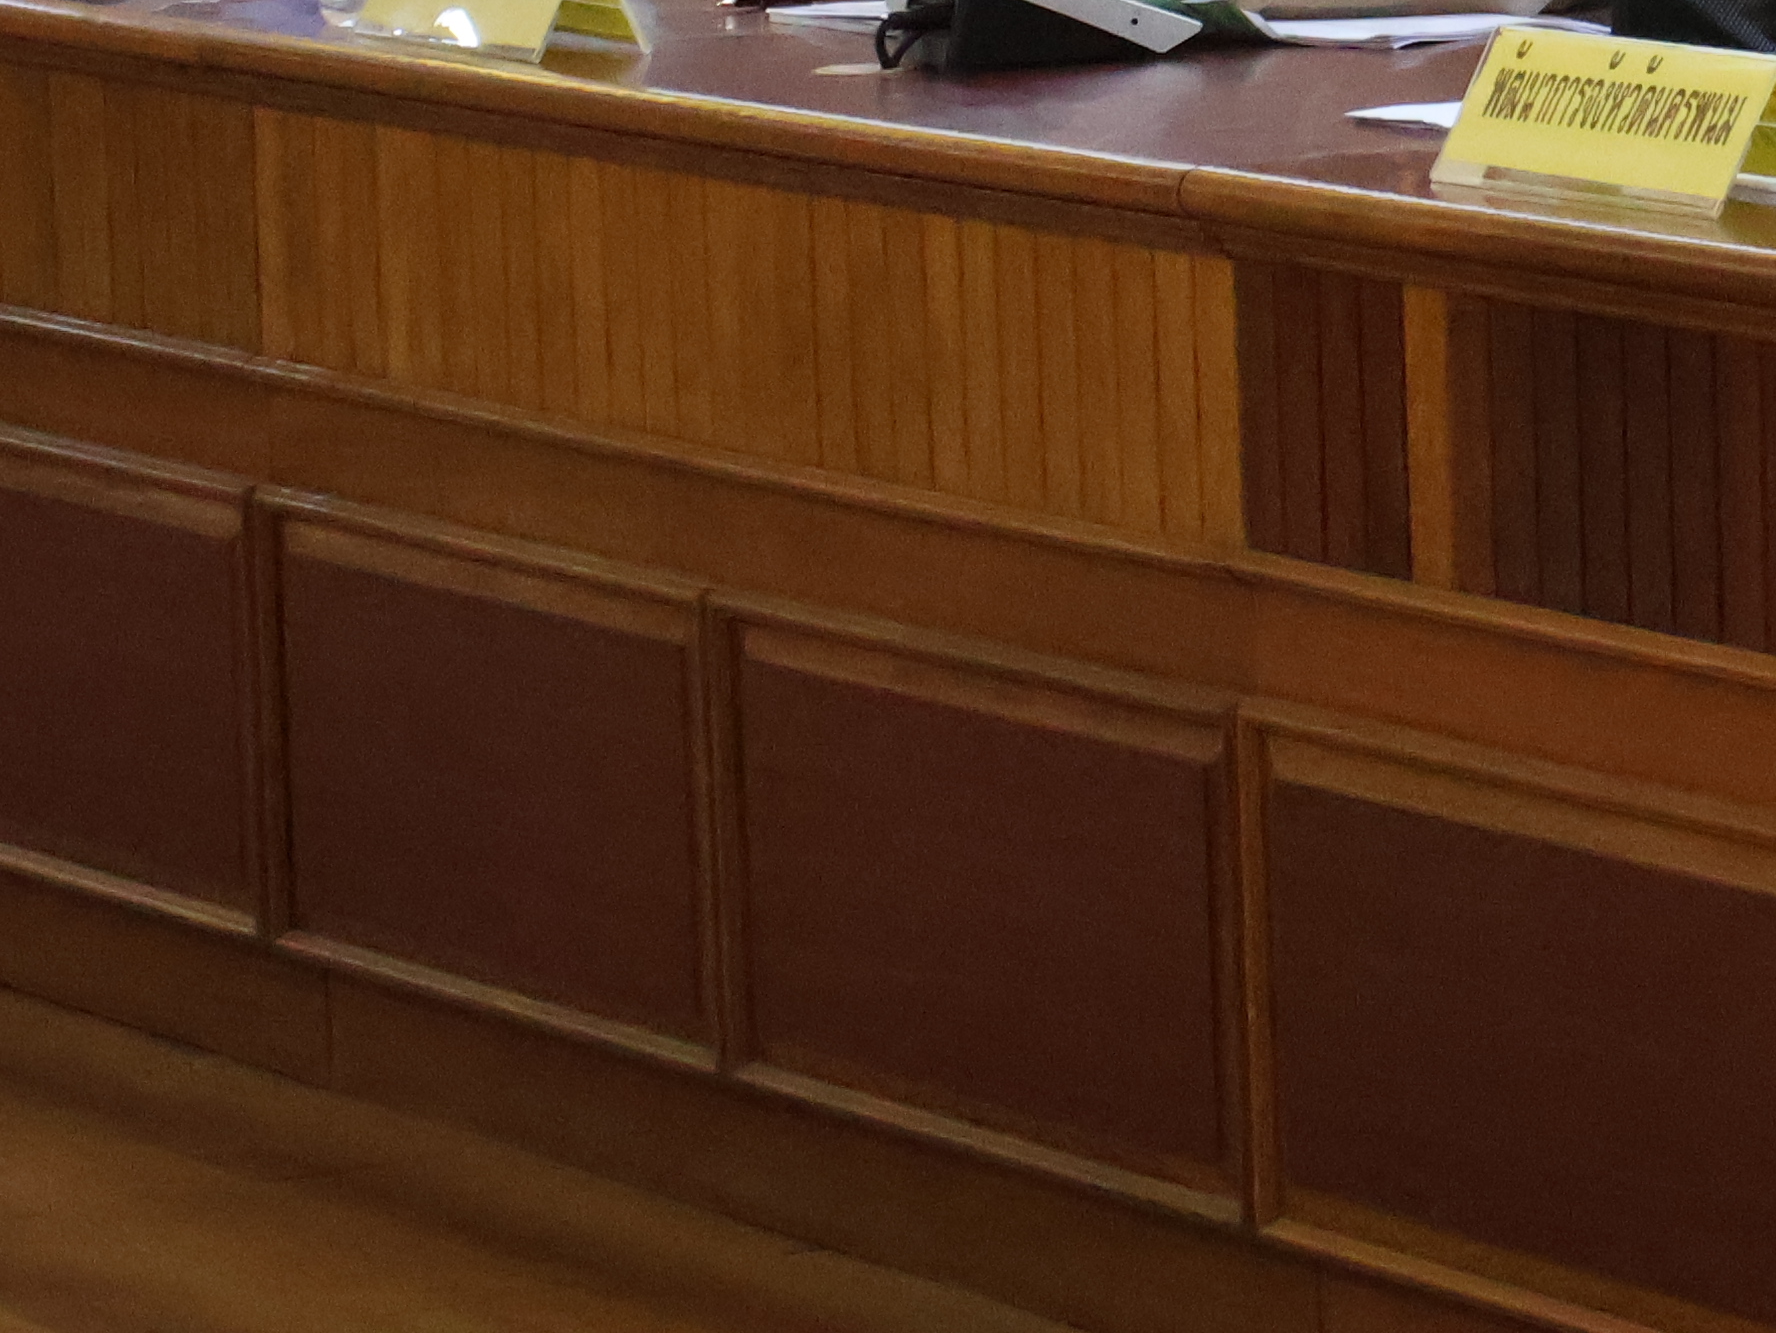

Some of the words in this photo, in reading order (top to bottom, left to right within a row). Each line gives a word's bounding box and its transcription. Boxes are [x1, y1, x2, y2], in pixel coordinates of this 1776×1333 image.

[1482, 39, 1749, 146] พัฒนาการจังหวัดนครพนม
